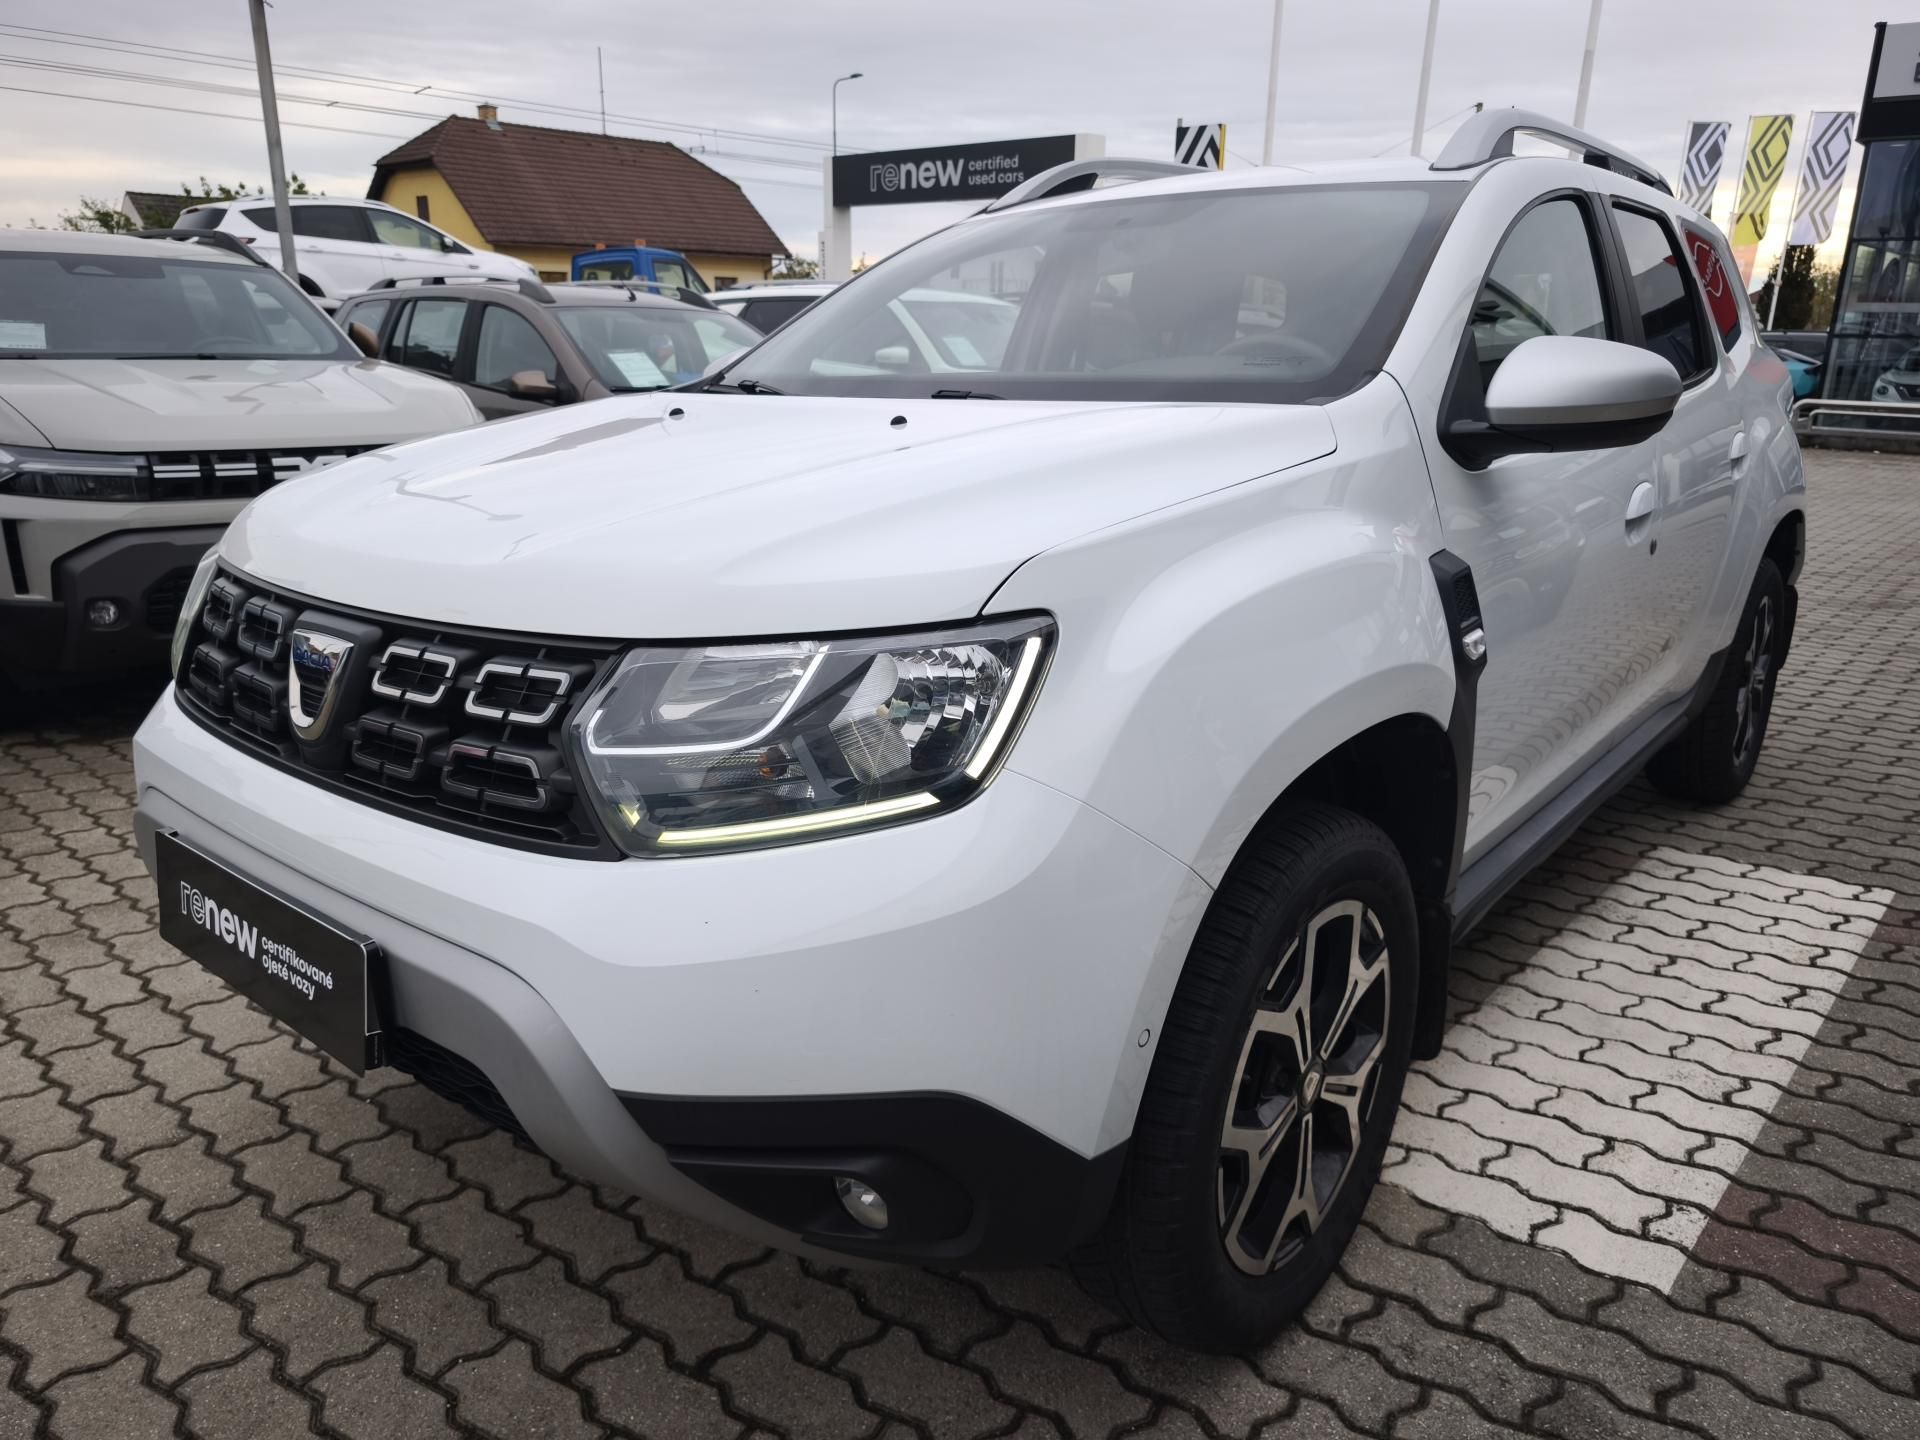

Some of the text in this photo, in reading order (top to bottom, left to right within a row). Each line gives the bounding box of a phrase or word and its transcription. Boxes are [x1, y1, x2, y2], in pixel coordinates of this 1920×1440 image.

[870, 158, 964, 192] renew
[968, 154, 1019, 171] certified
[968, 170, 1025, 186] used cars
[180, 880, 258, 960] renew
[261, 936, 333, 990] certifikované
[262, 953, 316, 1001] ojeté vozy
